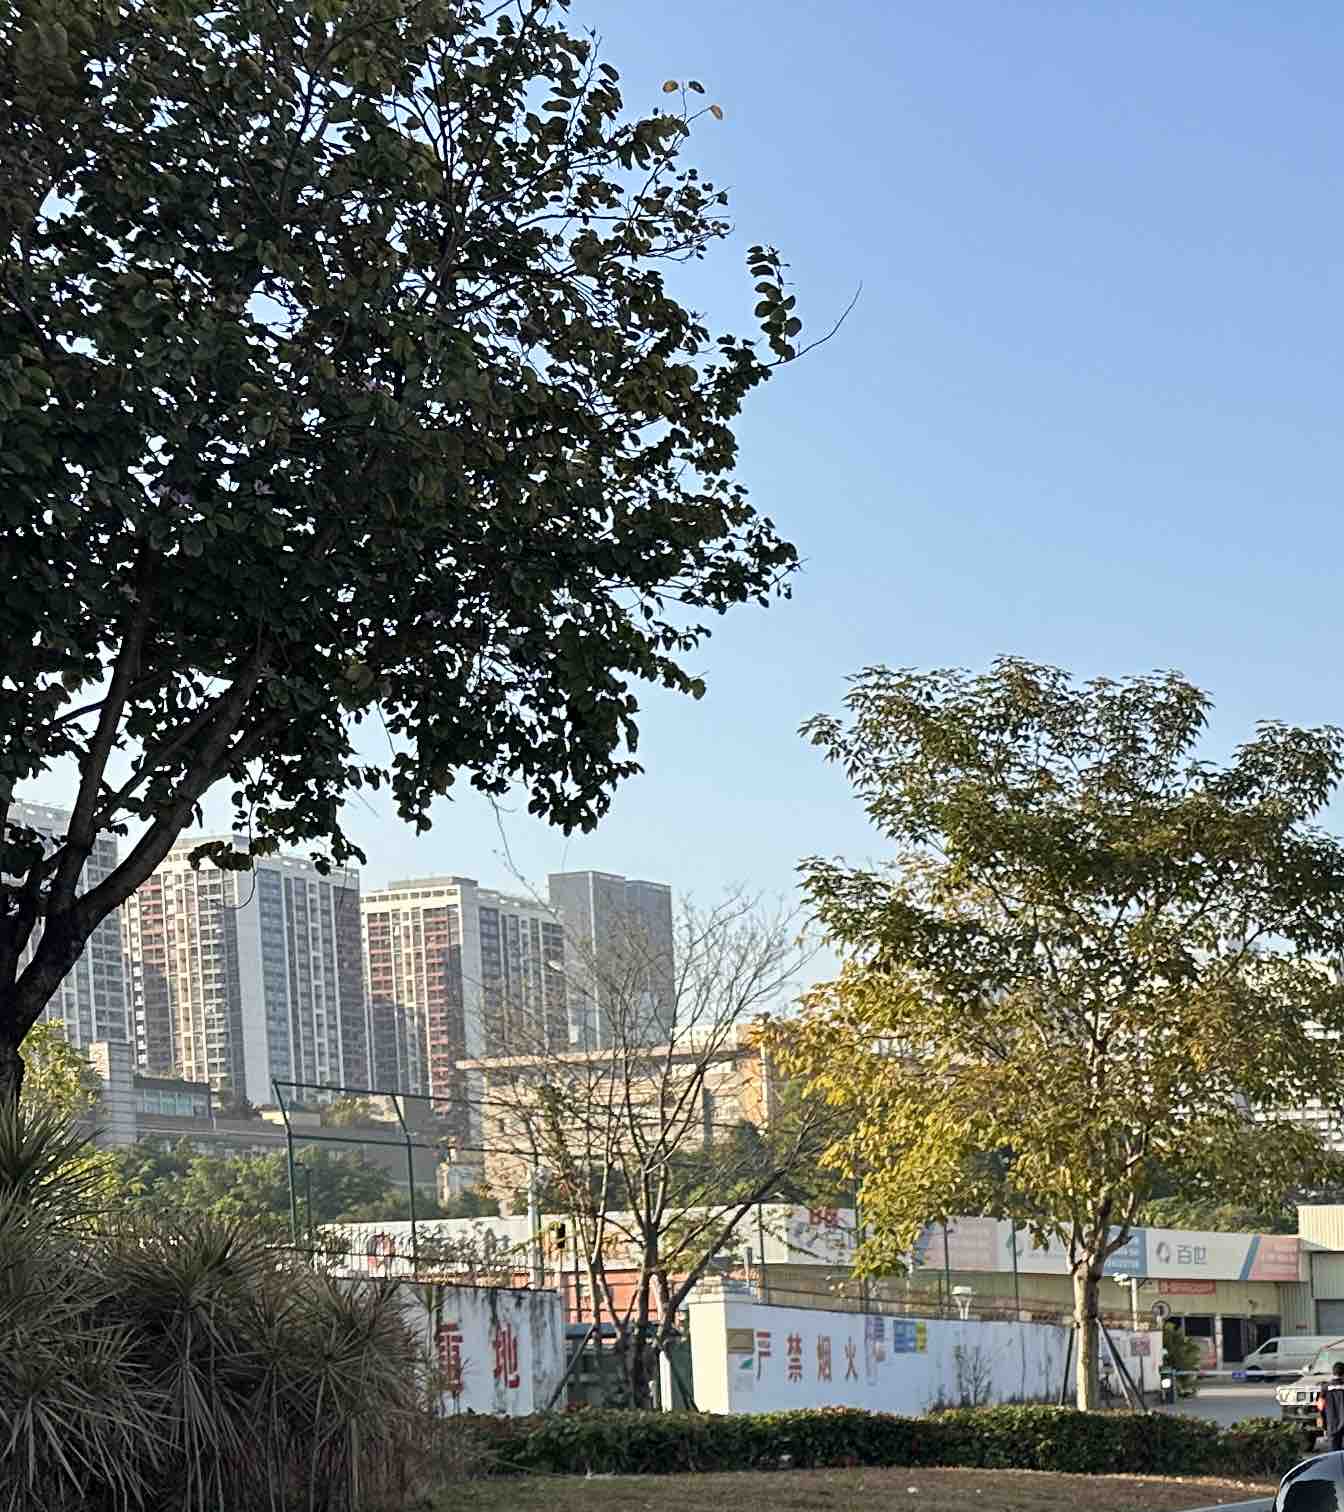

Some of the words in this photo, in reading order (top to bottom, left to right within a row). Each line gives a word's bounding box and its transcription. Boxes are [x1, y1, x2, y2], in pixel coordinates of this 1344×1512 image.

[1176, 1244, 1206, 1265] 百世
[756, 1331, 858, 1384] 严禁烟火
